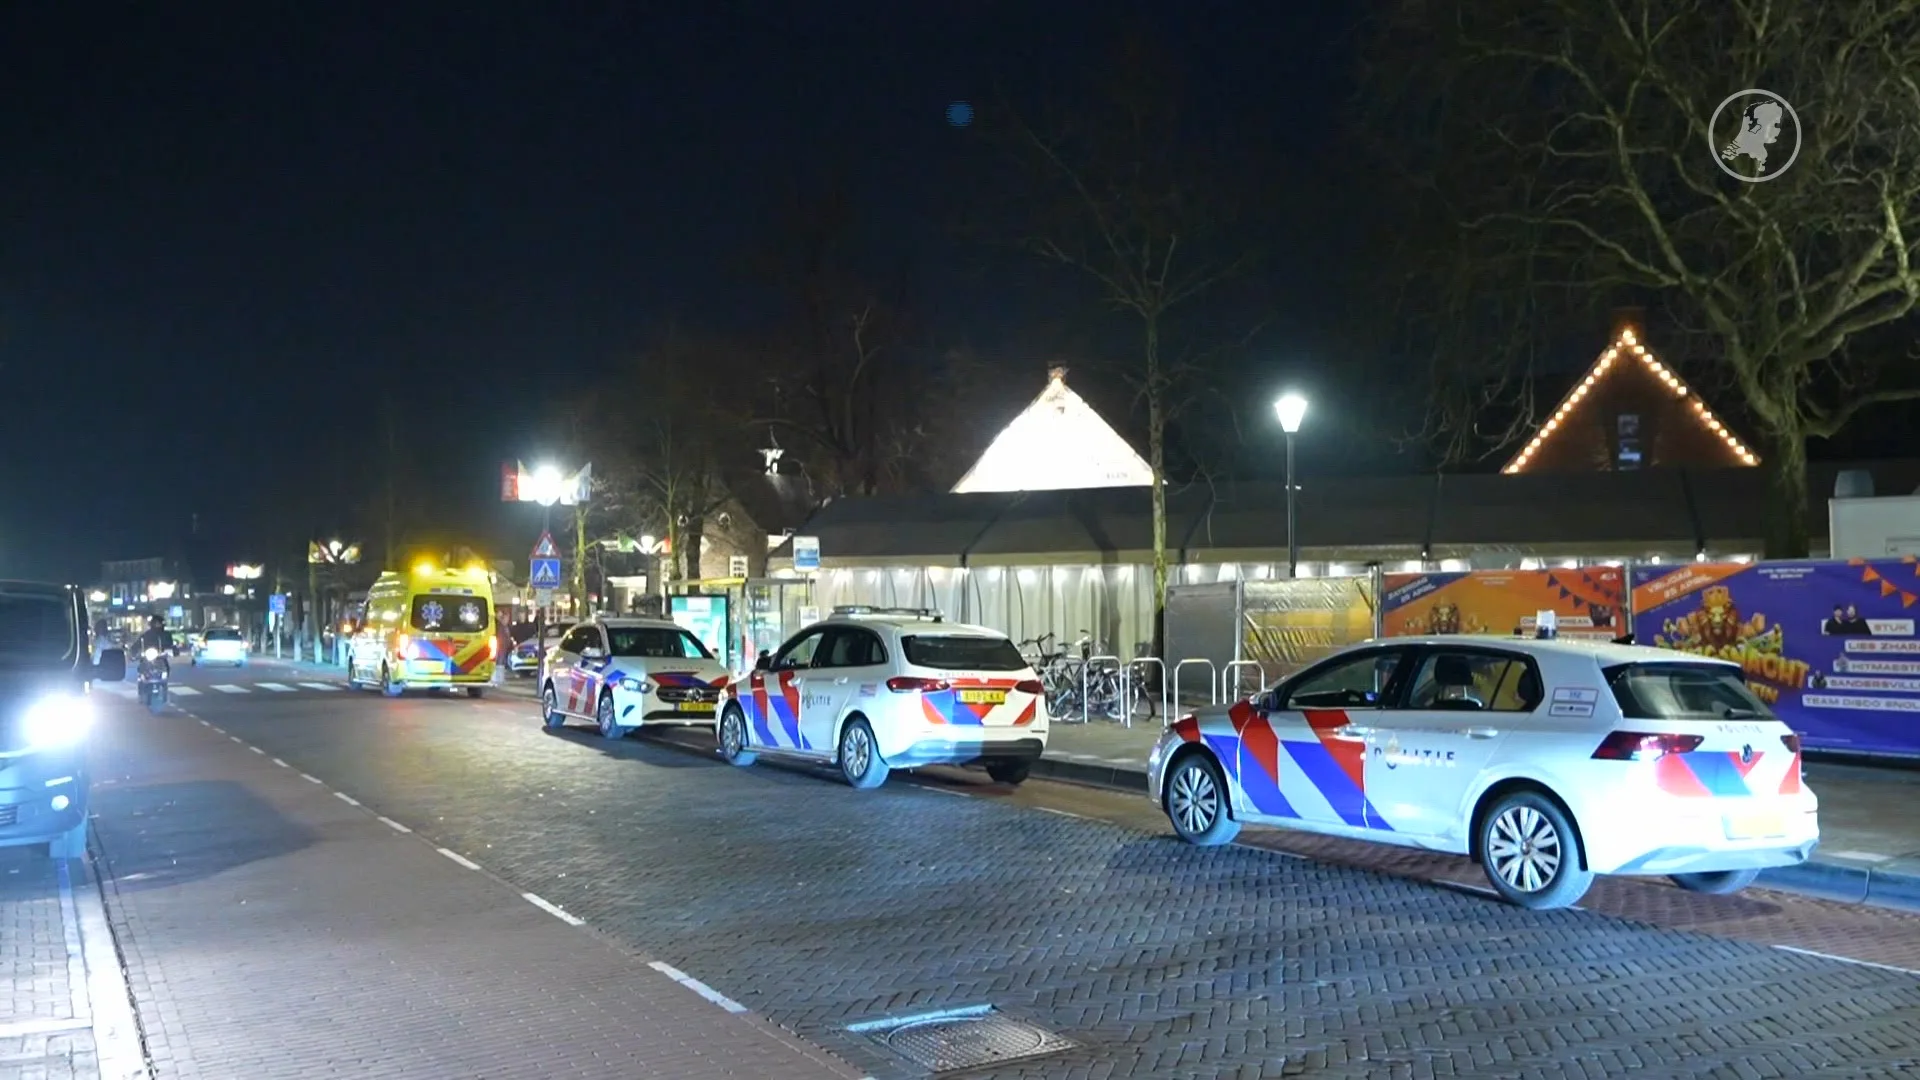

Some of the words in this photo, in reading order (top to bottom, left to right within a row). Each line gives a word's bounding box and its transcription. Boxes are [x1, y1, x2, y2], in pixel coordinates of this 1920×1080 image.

[1874, 624, 1908, 632] STUK
[1848, 642, 1876, 650] LIES
[1806, 697, 1839, 705] TEAM
[1843, 698, 1880, 707] DISCO
